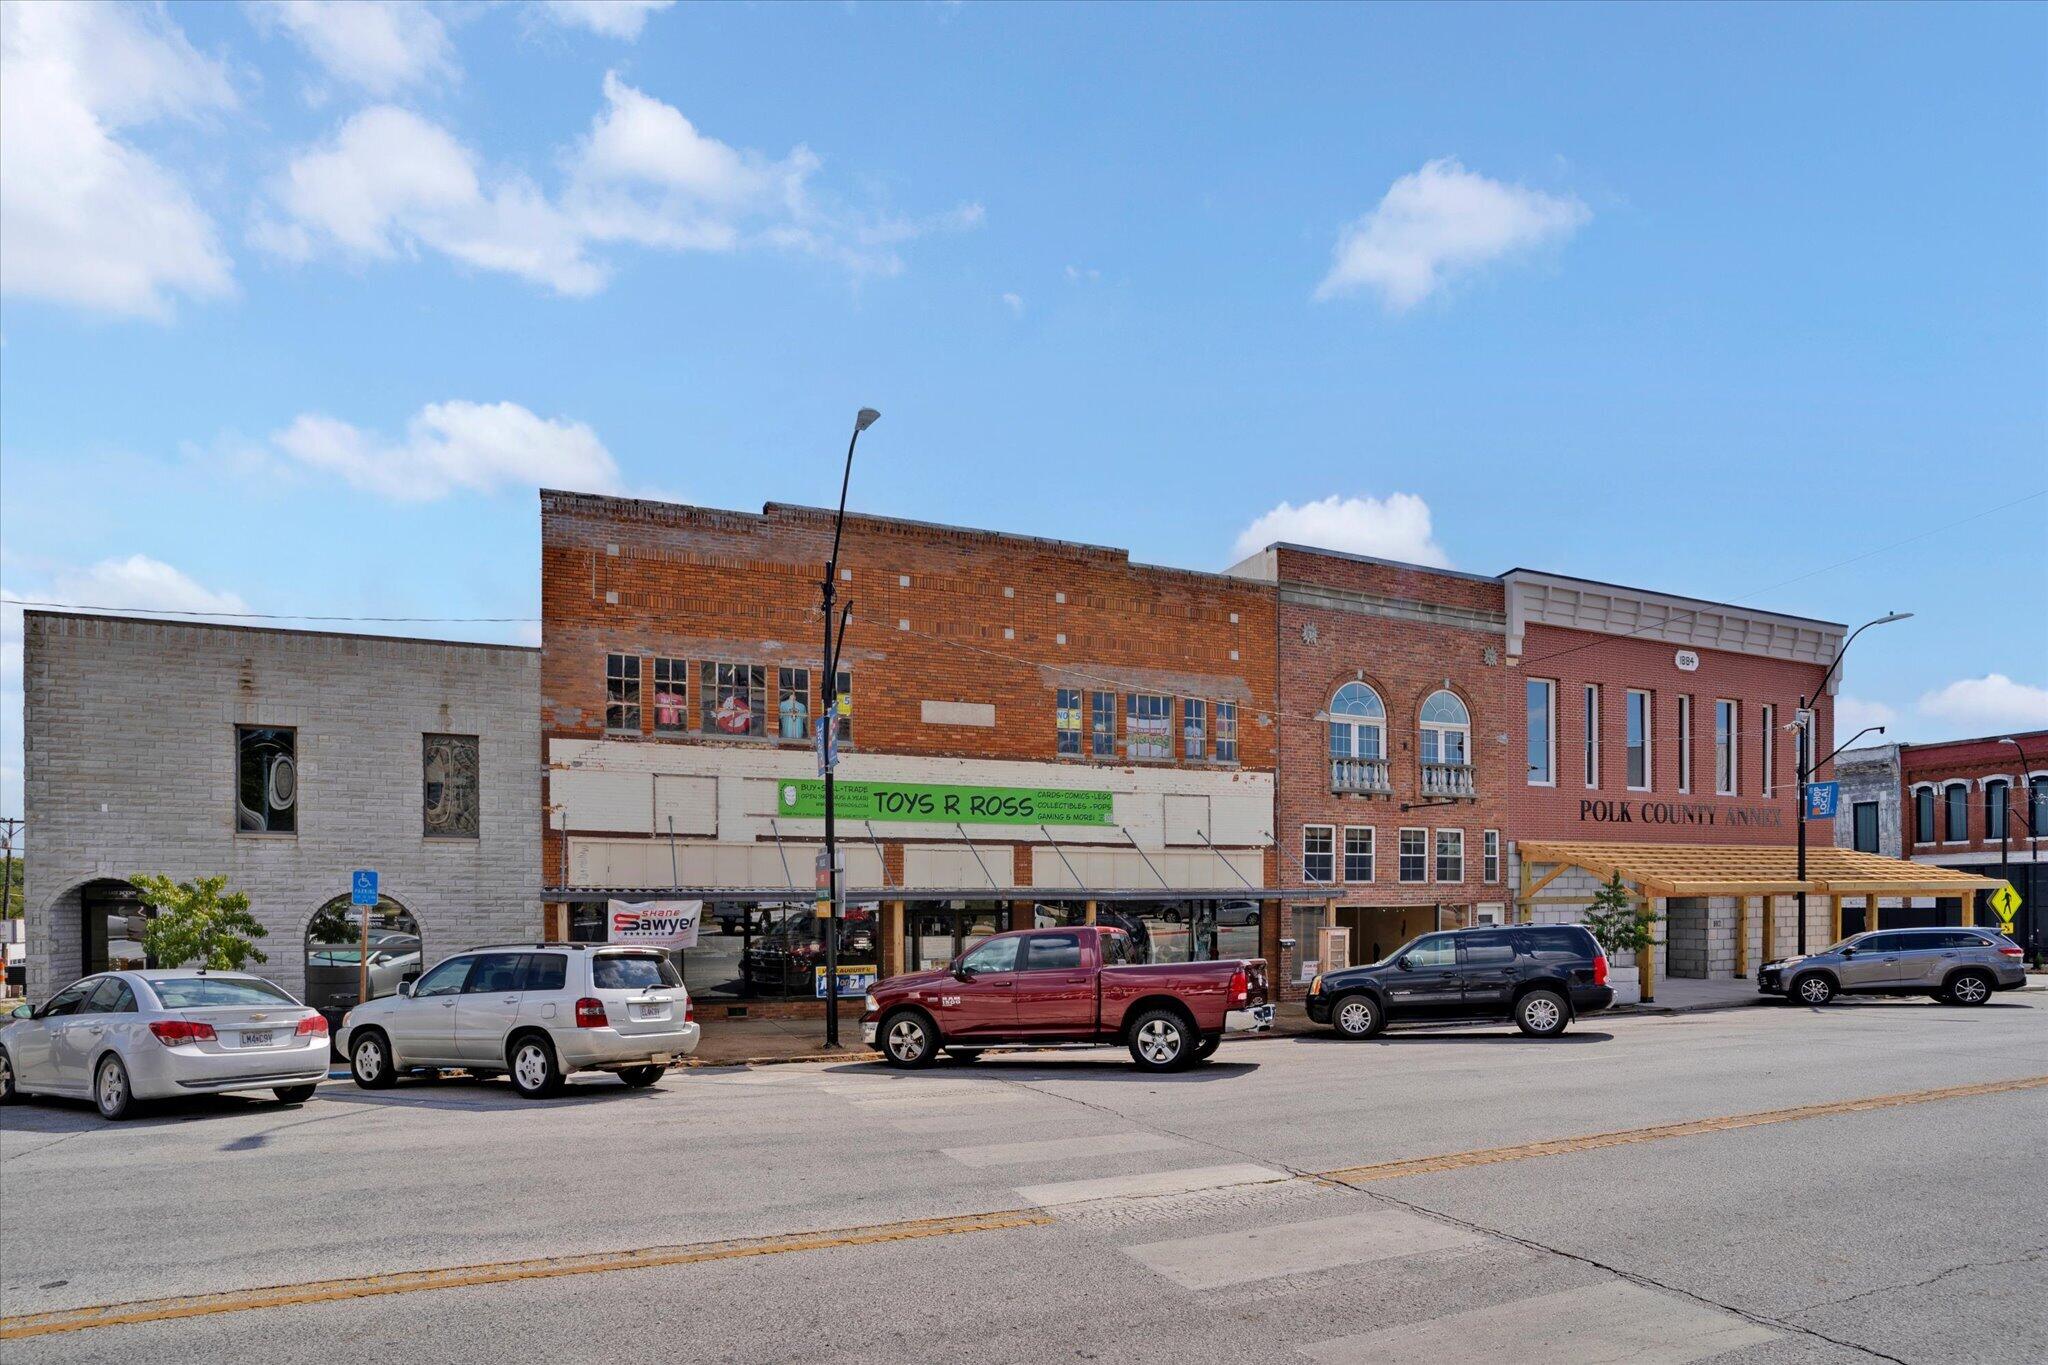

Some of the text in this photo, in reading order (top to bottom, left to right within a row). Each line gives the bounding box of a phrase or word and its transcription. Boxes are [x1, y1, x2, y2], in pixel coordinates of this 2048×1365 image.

[1680, 656, 1695, 666] 1884
[801, 783, 816, 792] BUY
[1812, 786, 1821, 806] SHOP
[1820, 785, 1829, 815] LOCAL
[873, 792, 1034, 817] TOYS R ROSS
[1037, 802, 1087, 810] COLLECTIBLES
[1037, 813, 1064, 821] GAMING
[1580, 800, 1781, 828] POLK COUNTY ANNEX
[613, 913, 696, 936] Sawyer
[850, 978, 858, 988] 7
